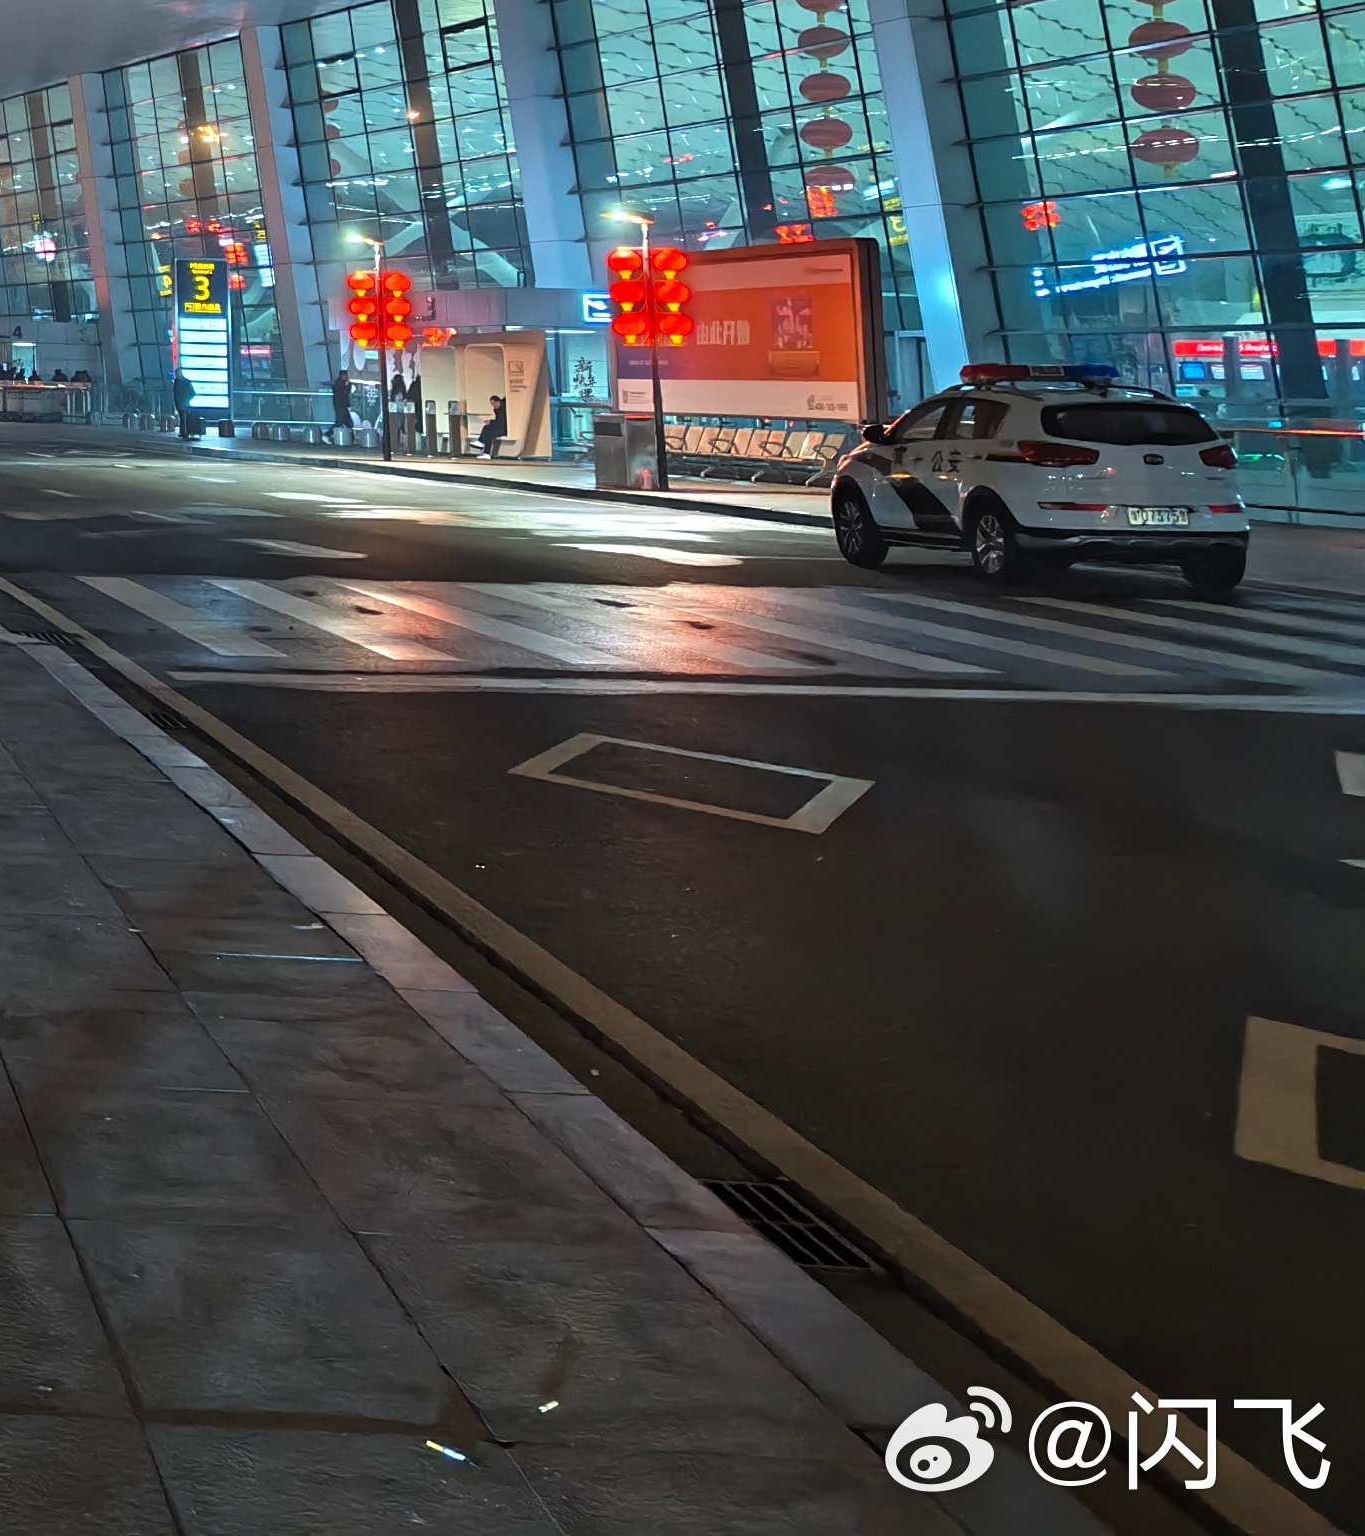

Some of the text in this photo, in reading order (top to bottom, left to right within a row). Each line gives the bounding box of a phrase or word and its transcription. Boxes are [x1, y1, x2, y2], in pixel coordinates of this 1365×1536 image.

[195, 276, 210, 301] 3
[12, 326, 22, 338] 4
[931, 449, 962, 473] 公安
